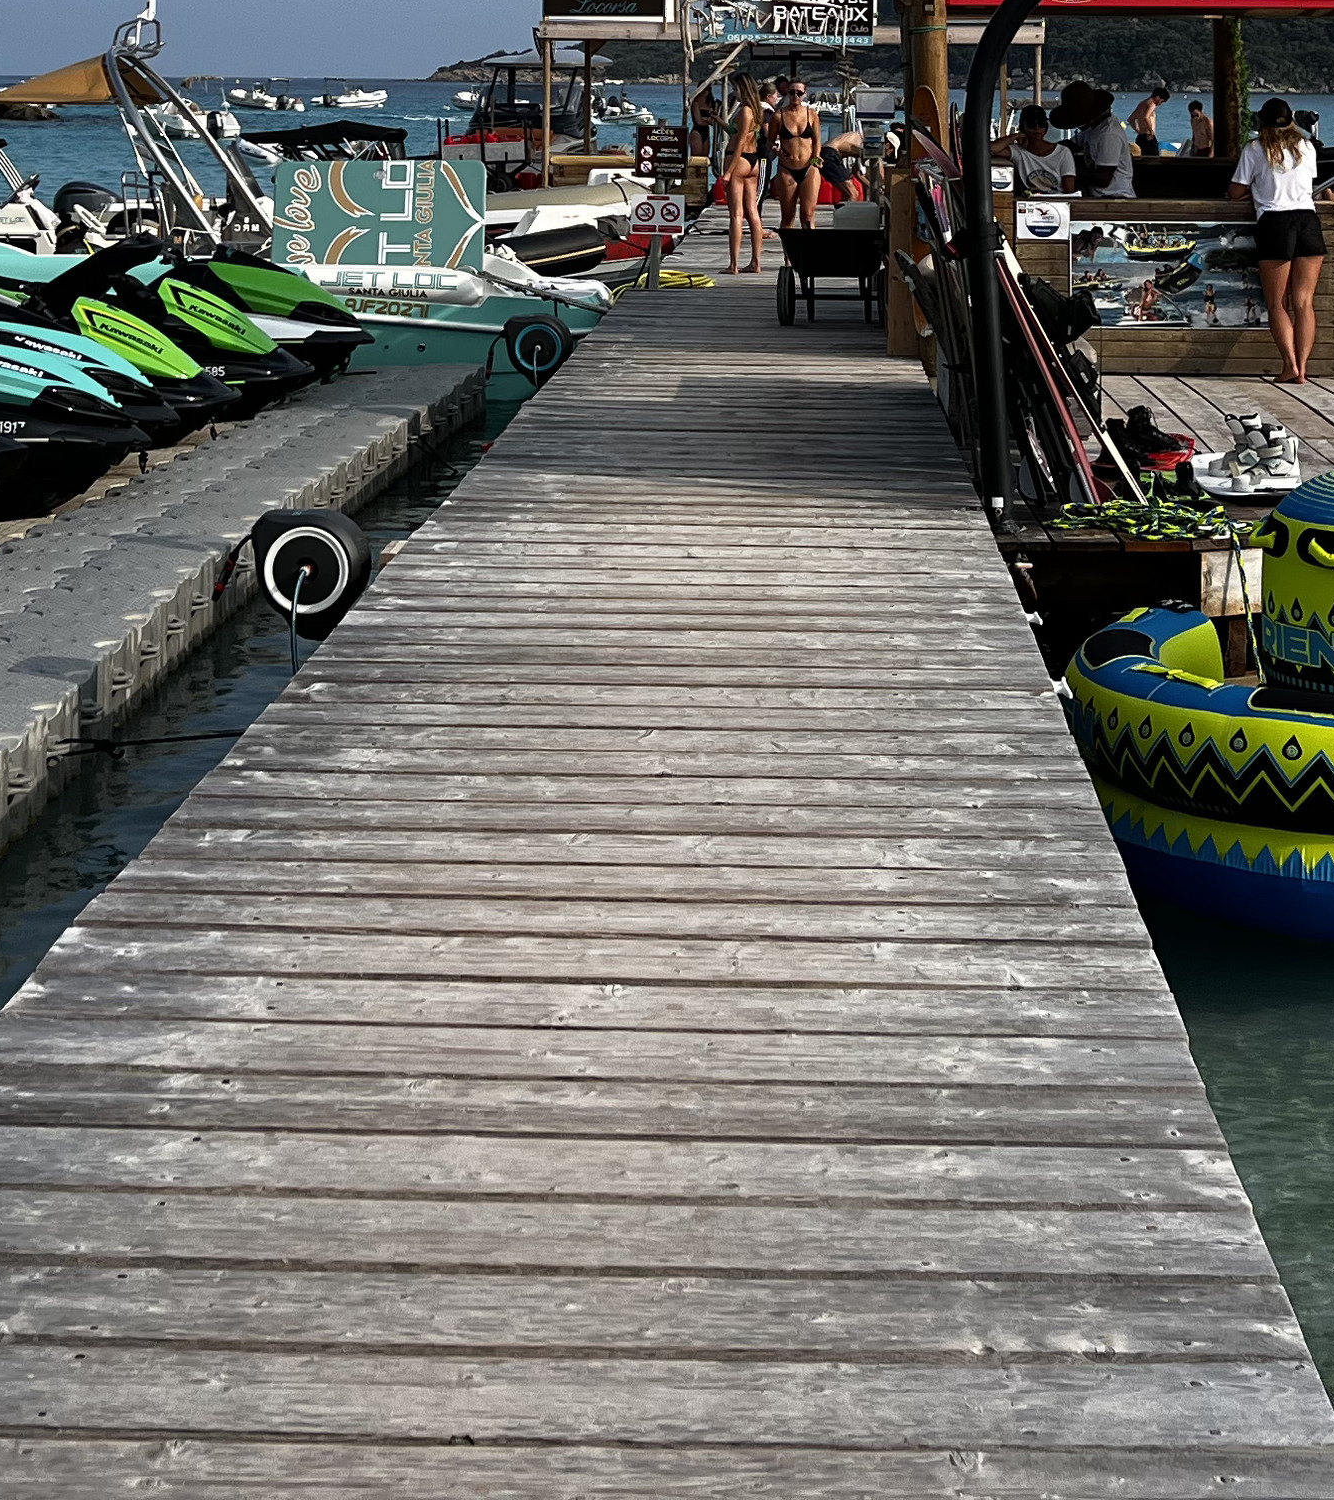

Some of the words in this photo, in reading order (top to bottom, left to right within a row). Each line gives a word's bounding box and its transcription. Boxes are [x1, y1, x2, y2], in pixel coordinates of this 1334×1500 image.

[273, 164, 322, 232] love
[380, 160, 415, 221] LO
[414, 160, 436, 224] GIULIA
[413, 228, 433, 266] NTA
[320, 271, 385, 287] JET
[392, 272, 458, 291] LOC
[348, 287, 386, 297] SANTA
[389, 289, 428, 298] GIULIA
[188, 304, 247, 336] Kawasaki
[99, 322, 164, 355] Kawasaki
